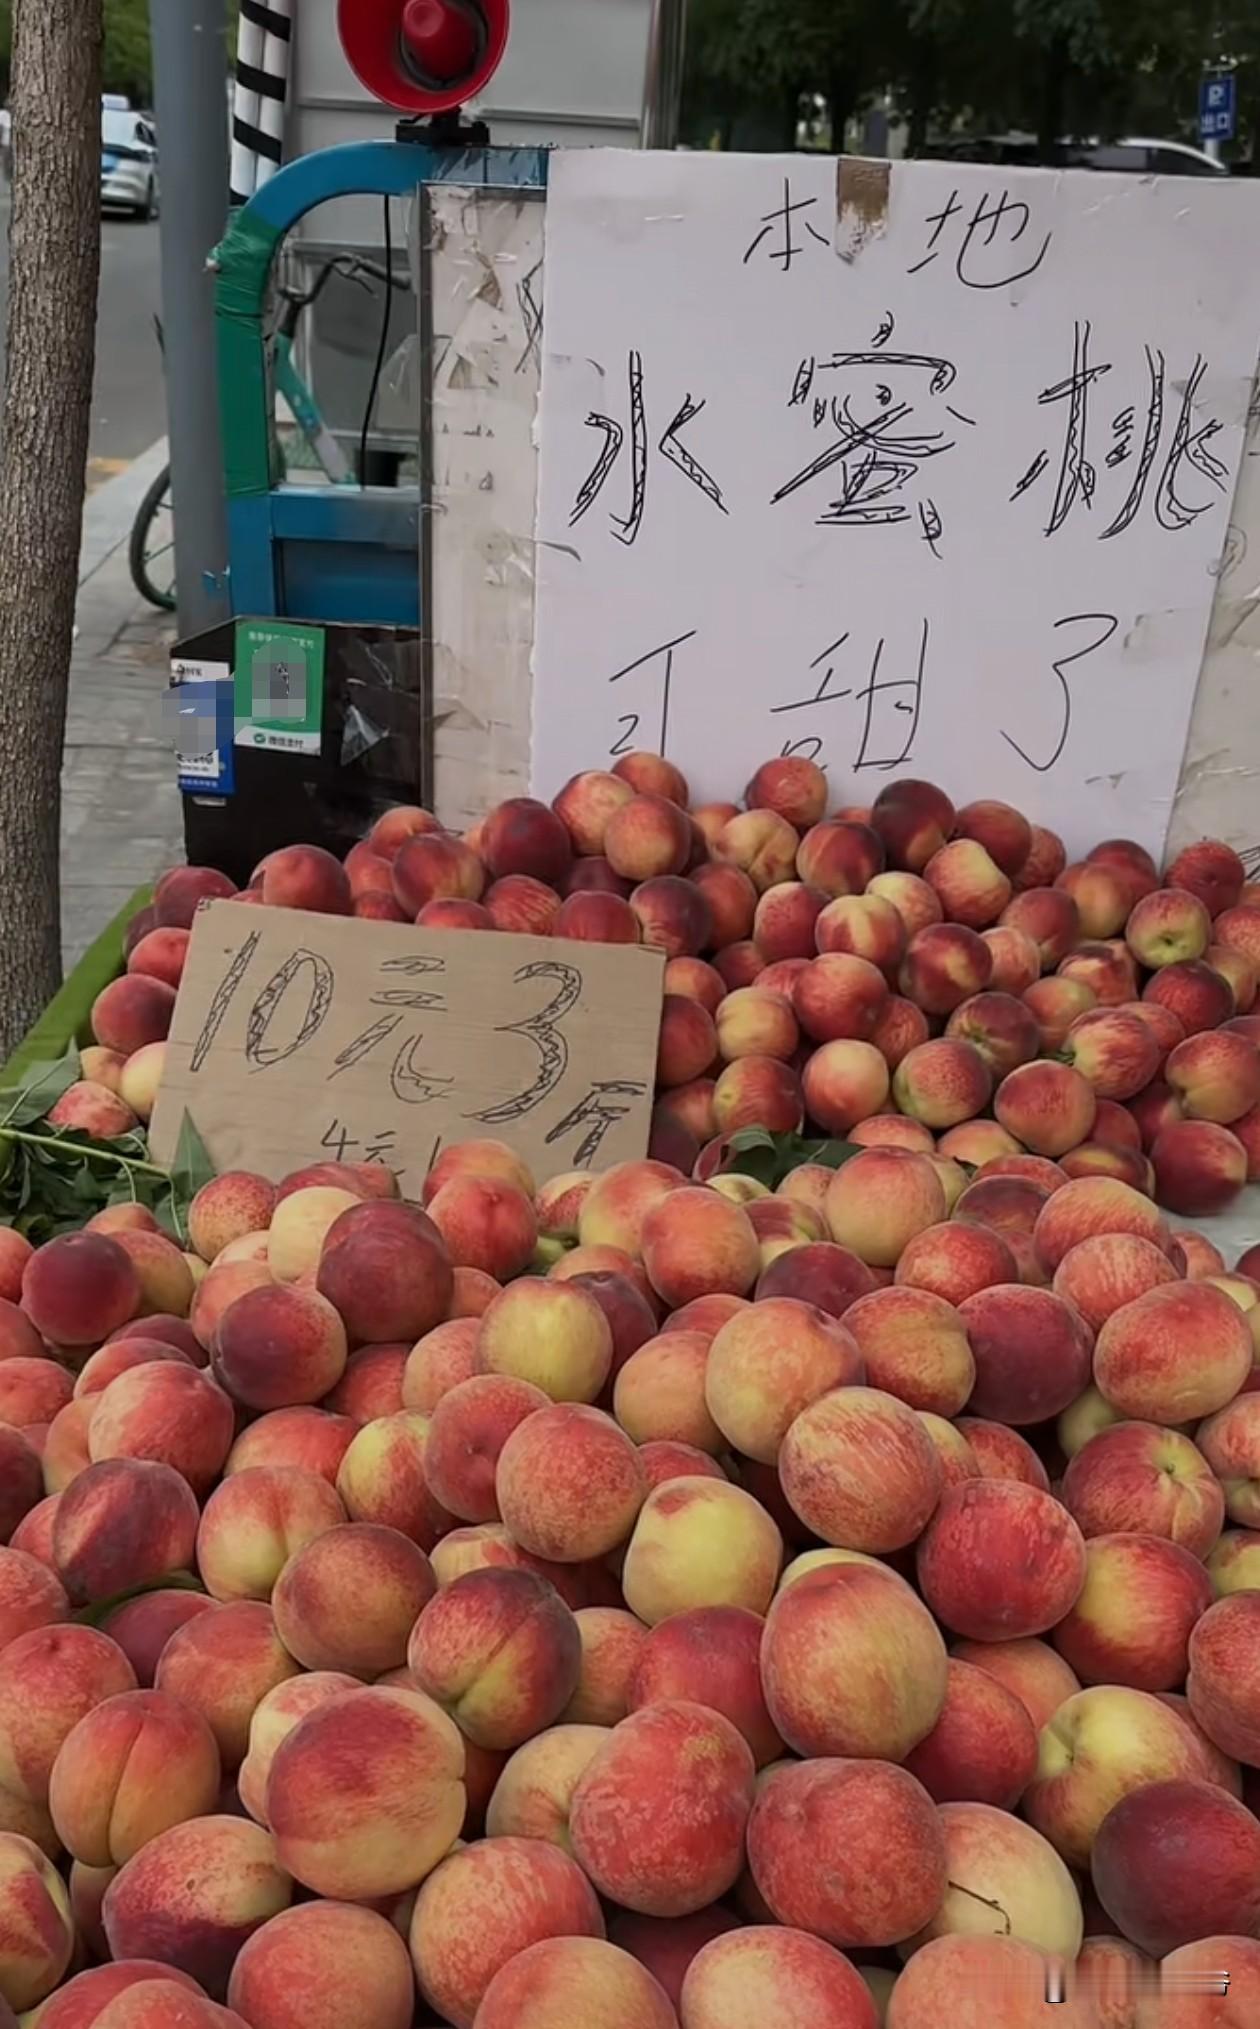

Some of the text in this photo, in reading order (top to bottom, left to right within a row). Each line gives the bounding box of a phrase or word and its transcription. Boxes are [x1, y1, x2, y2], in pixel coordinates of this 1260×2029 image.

[743, 178, 1054, 289] 本地
[569, 311, 1230, 559] 水蜜桃
[190, 929, 648, 1168] 10元3斤
